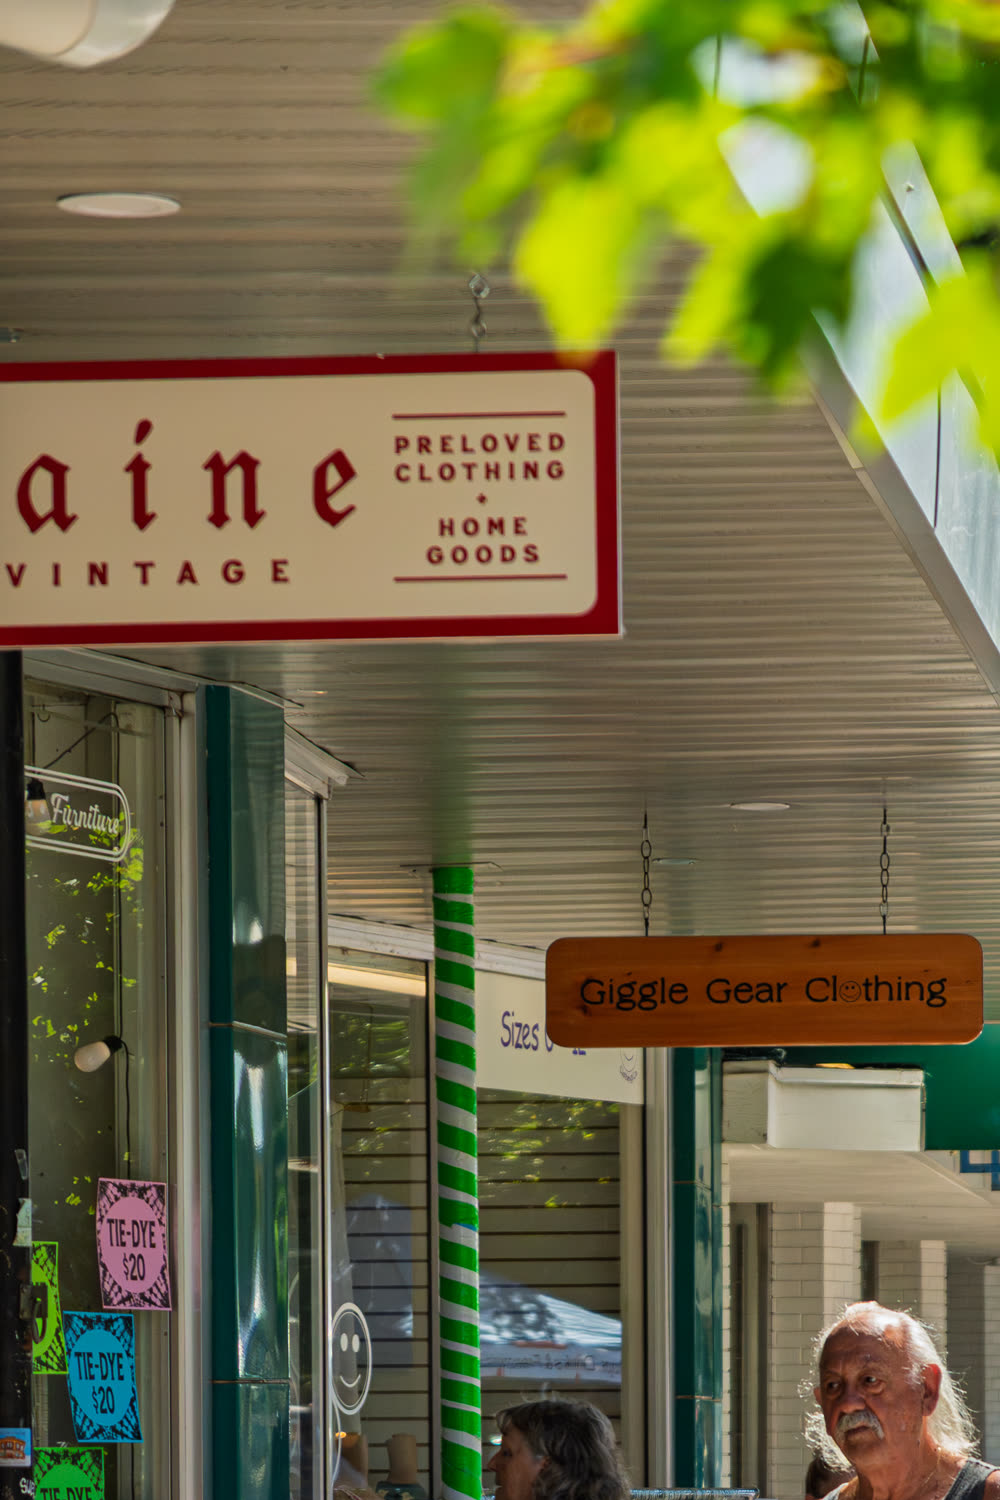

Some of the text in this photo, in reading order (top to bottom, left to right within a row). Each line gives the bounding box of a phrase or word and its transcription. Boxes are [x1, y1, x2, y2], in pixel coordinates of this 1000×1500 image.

[394, 433, 567, 456] PRELOVED
[394, 460, 566, 483] CLOTHING
[438, 516, 529, 538] HOME
[426, 543, 540, 565] GOODS
[5, 559, 291, 588] VINTAGE
[50, 792, 120, 835] Furniture
[579, 974, 948, 1011] Giggle Gear Clothing
[500, 1010, 540, 1051] Sizes
[106, 1218, 157, 1249] TIE-DYE
[122, 1252, 146, 1281] $20
[74, 1351, 125, 1381] TIE-DYE
[91, 1385, 115, 1414] $20
